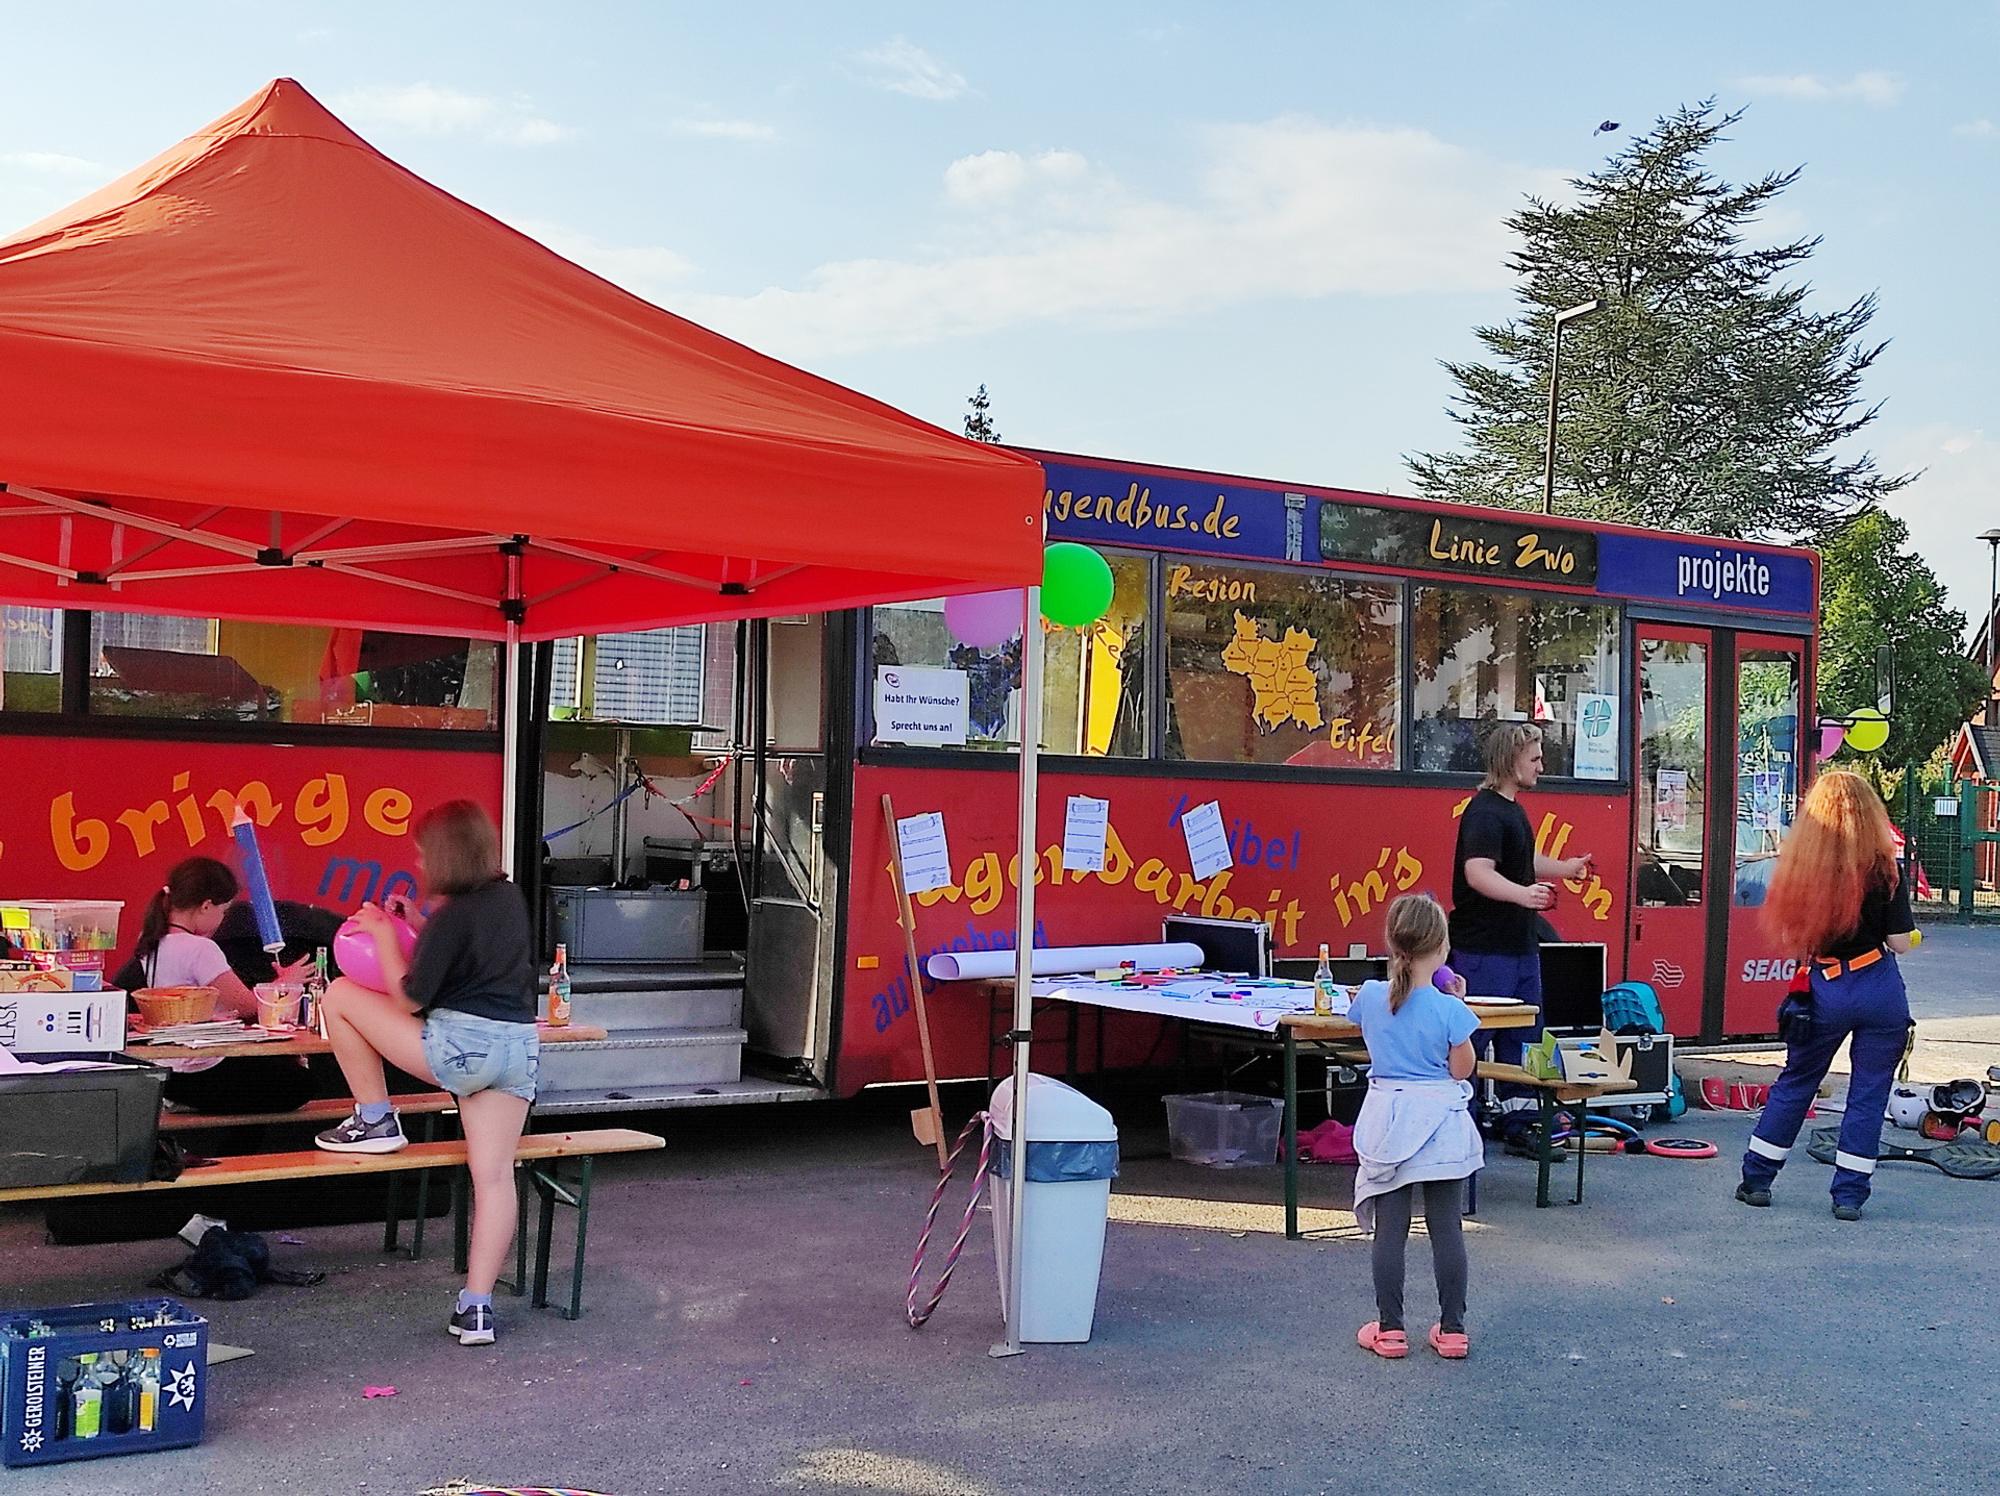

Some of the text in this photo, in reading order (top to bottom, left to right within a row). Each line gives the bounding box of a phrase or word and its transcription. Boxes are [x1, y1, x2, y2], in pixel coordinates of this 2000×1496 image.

[1430, 518, 1575, 574] Linie Zwo
[1169, 564, 1256, 603] Region
[1678, 550, 1770, 599] projekte
[884, 693, 960, 706] Habt Ihr Wünsche?
[891, 720, 953, 732] Sprecht uns an!
[1330, 717, 1396, 760] Eifel
[50, 770, 413, 872] bringe
[1330, 846, 1423, 928] in's
[25, 1345, 46, 1428] GEROLSTEINER
